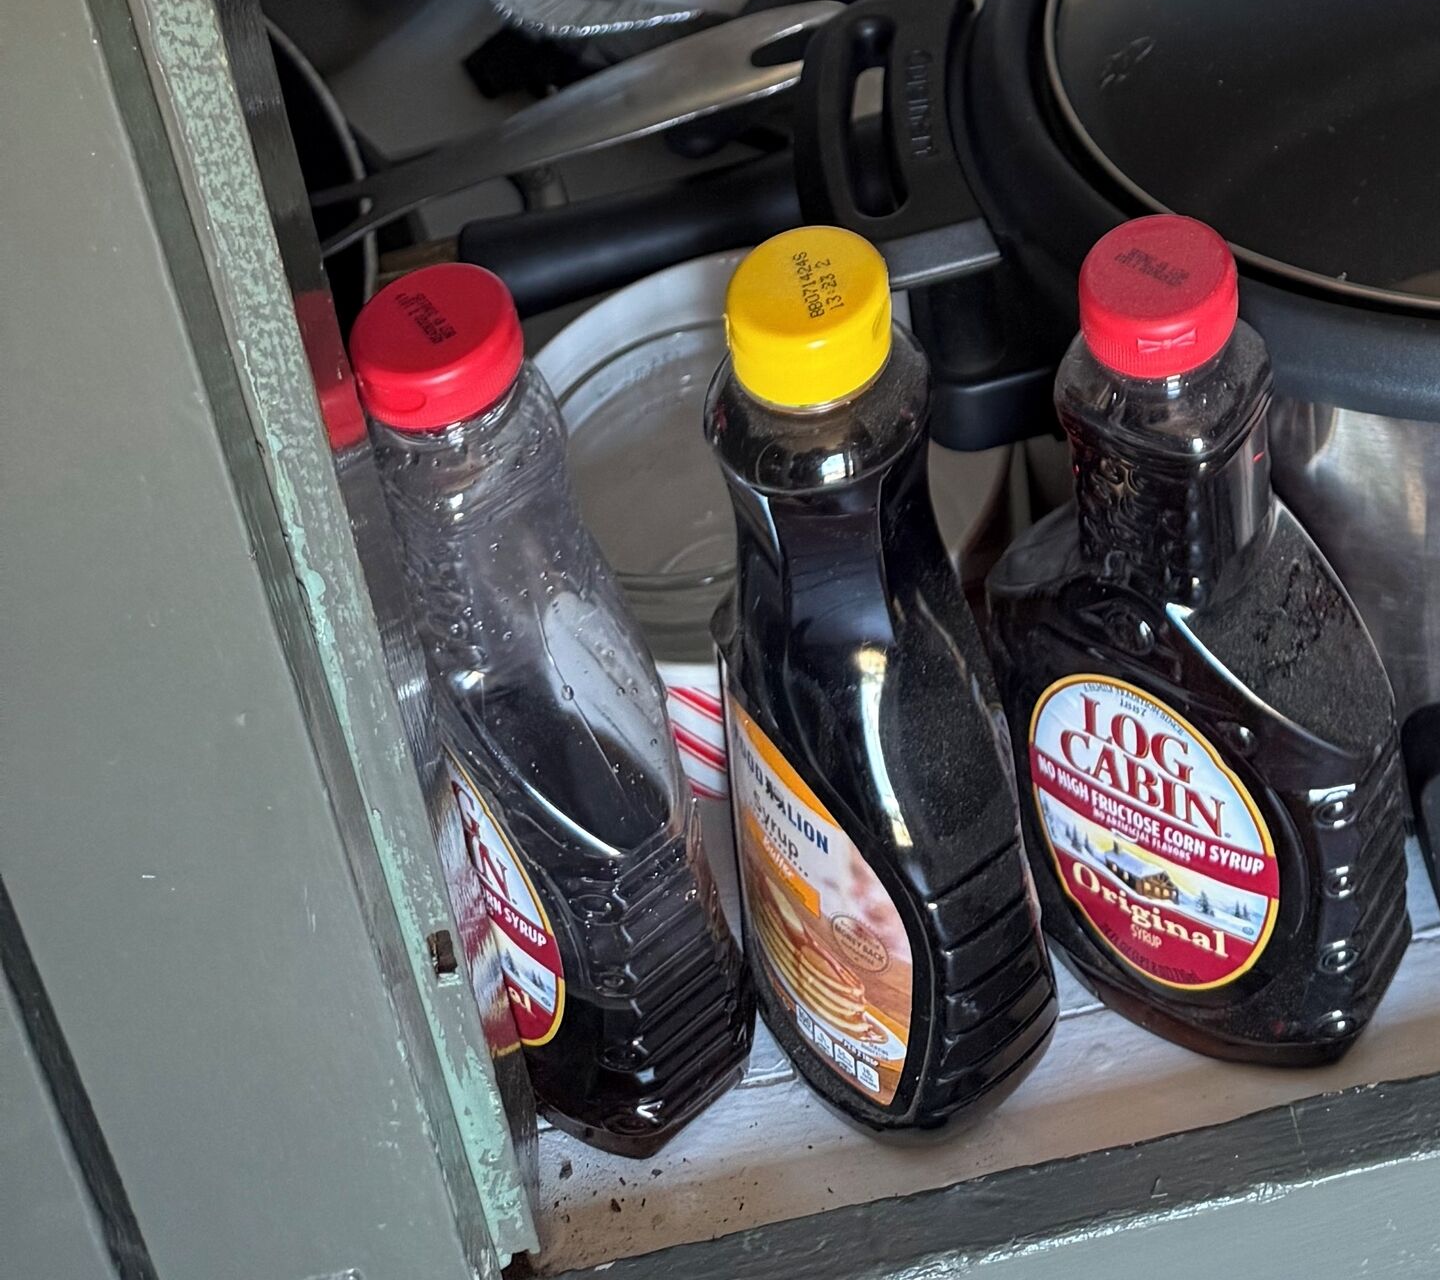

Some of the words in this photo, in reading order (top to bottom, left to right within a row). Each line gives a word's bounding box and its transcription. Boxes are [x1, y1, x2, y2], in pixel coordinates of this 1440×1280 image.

[1060, 729, 1226, 839] CABIN
[1079, 692, 1195, 785] LOG
[787, 802, 829, 854] LION
[1038, 753, 1056, 776] NO
[1057, 767, 1089, 800] HIGH
[1091, 786, 1161, 835] FRUCTOSE
[1164, 826, 1206, 858] CORN
[1209, 843, 1265, 876] SYRUP
[504, 906, 548, 948] SYRUP
[1072, 861, 1229, 958] Original
[1130, 923, 1163, 950] SYRUP
